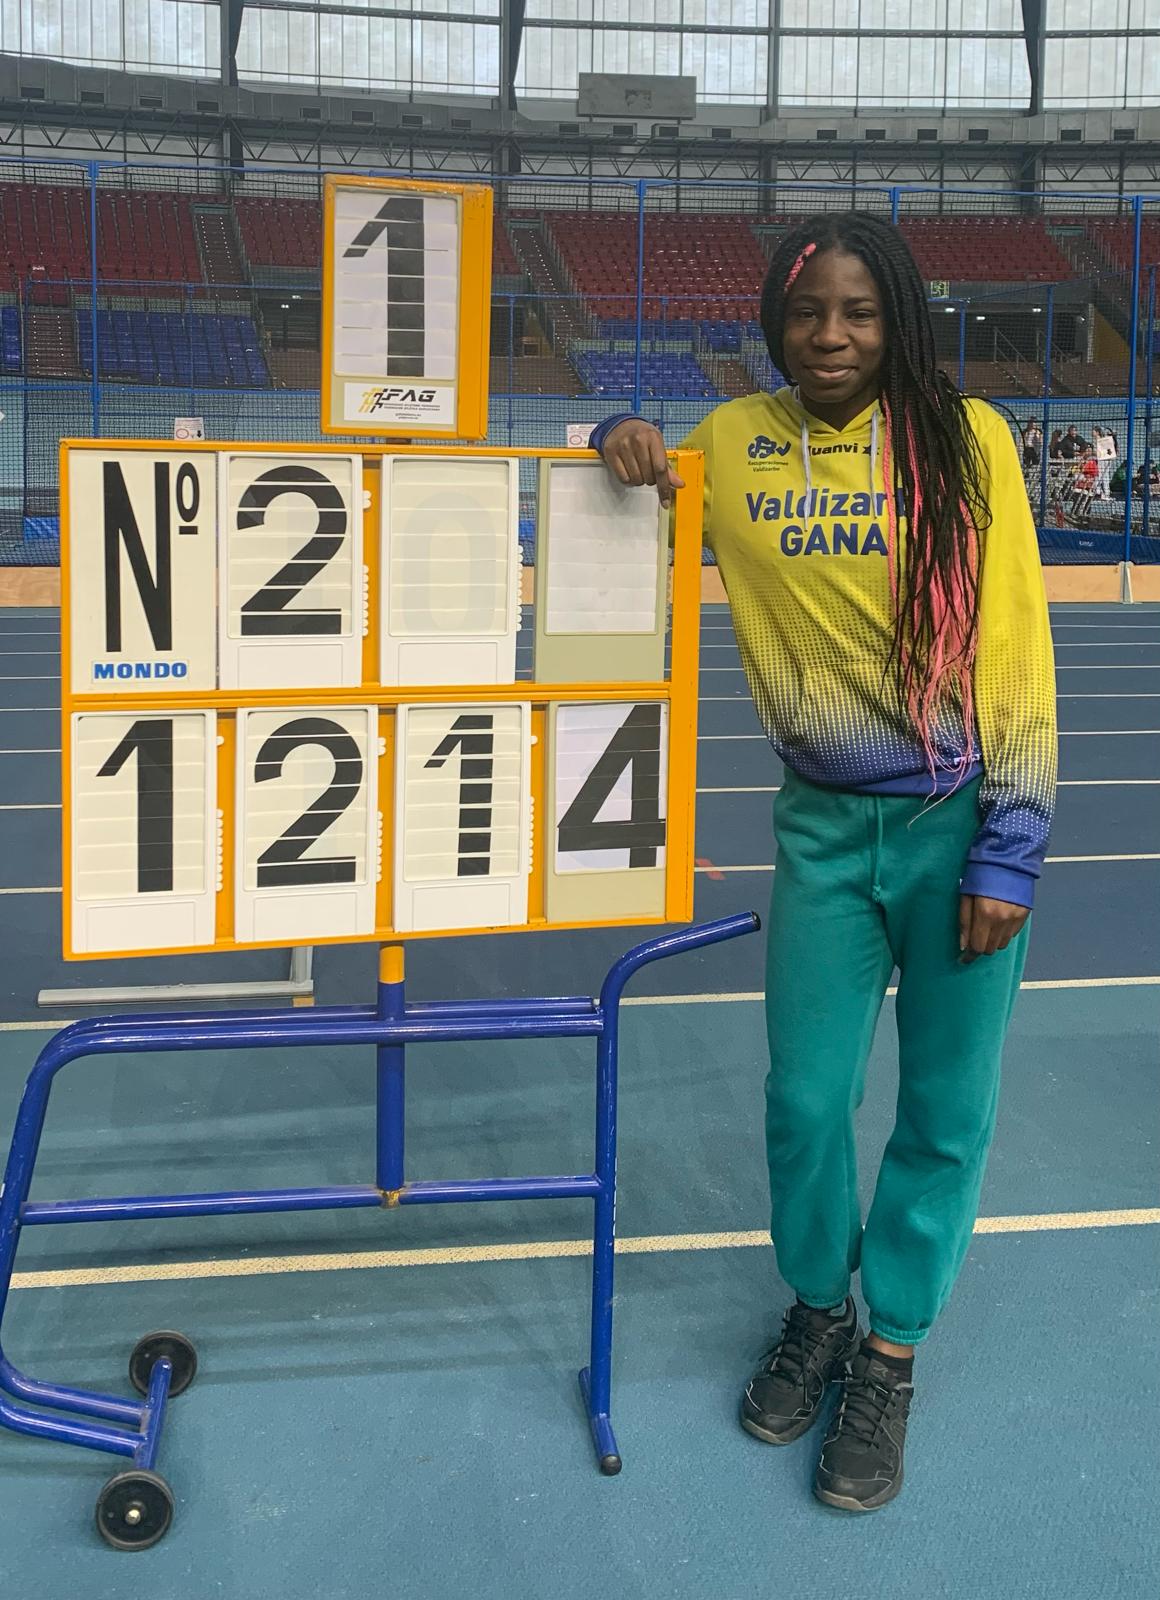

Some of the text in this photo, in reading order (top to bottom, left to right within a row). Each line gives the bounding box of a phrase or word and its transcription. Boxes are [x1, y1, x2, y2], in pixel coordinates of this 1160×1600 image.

[343, 197, 425, 377] 1
[237, 465, 347, 635] 2
[780, 523, 889, 557] GANA
[94, 662, 188, 680] MONDO
